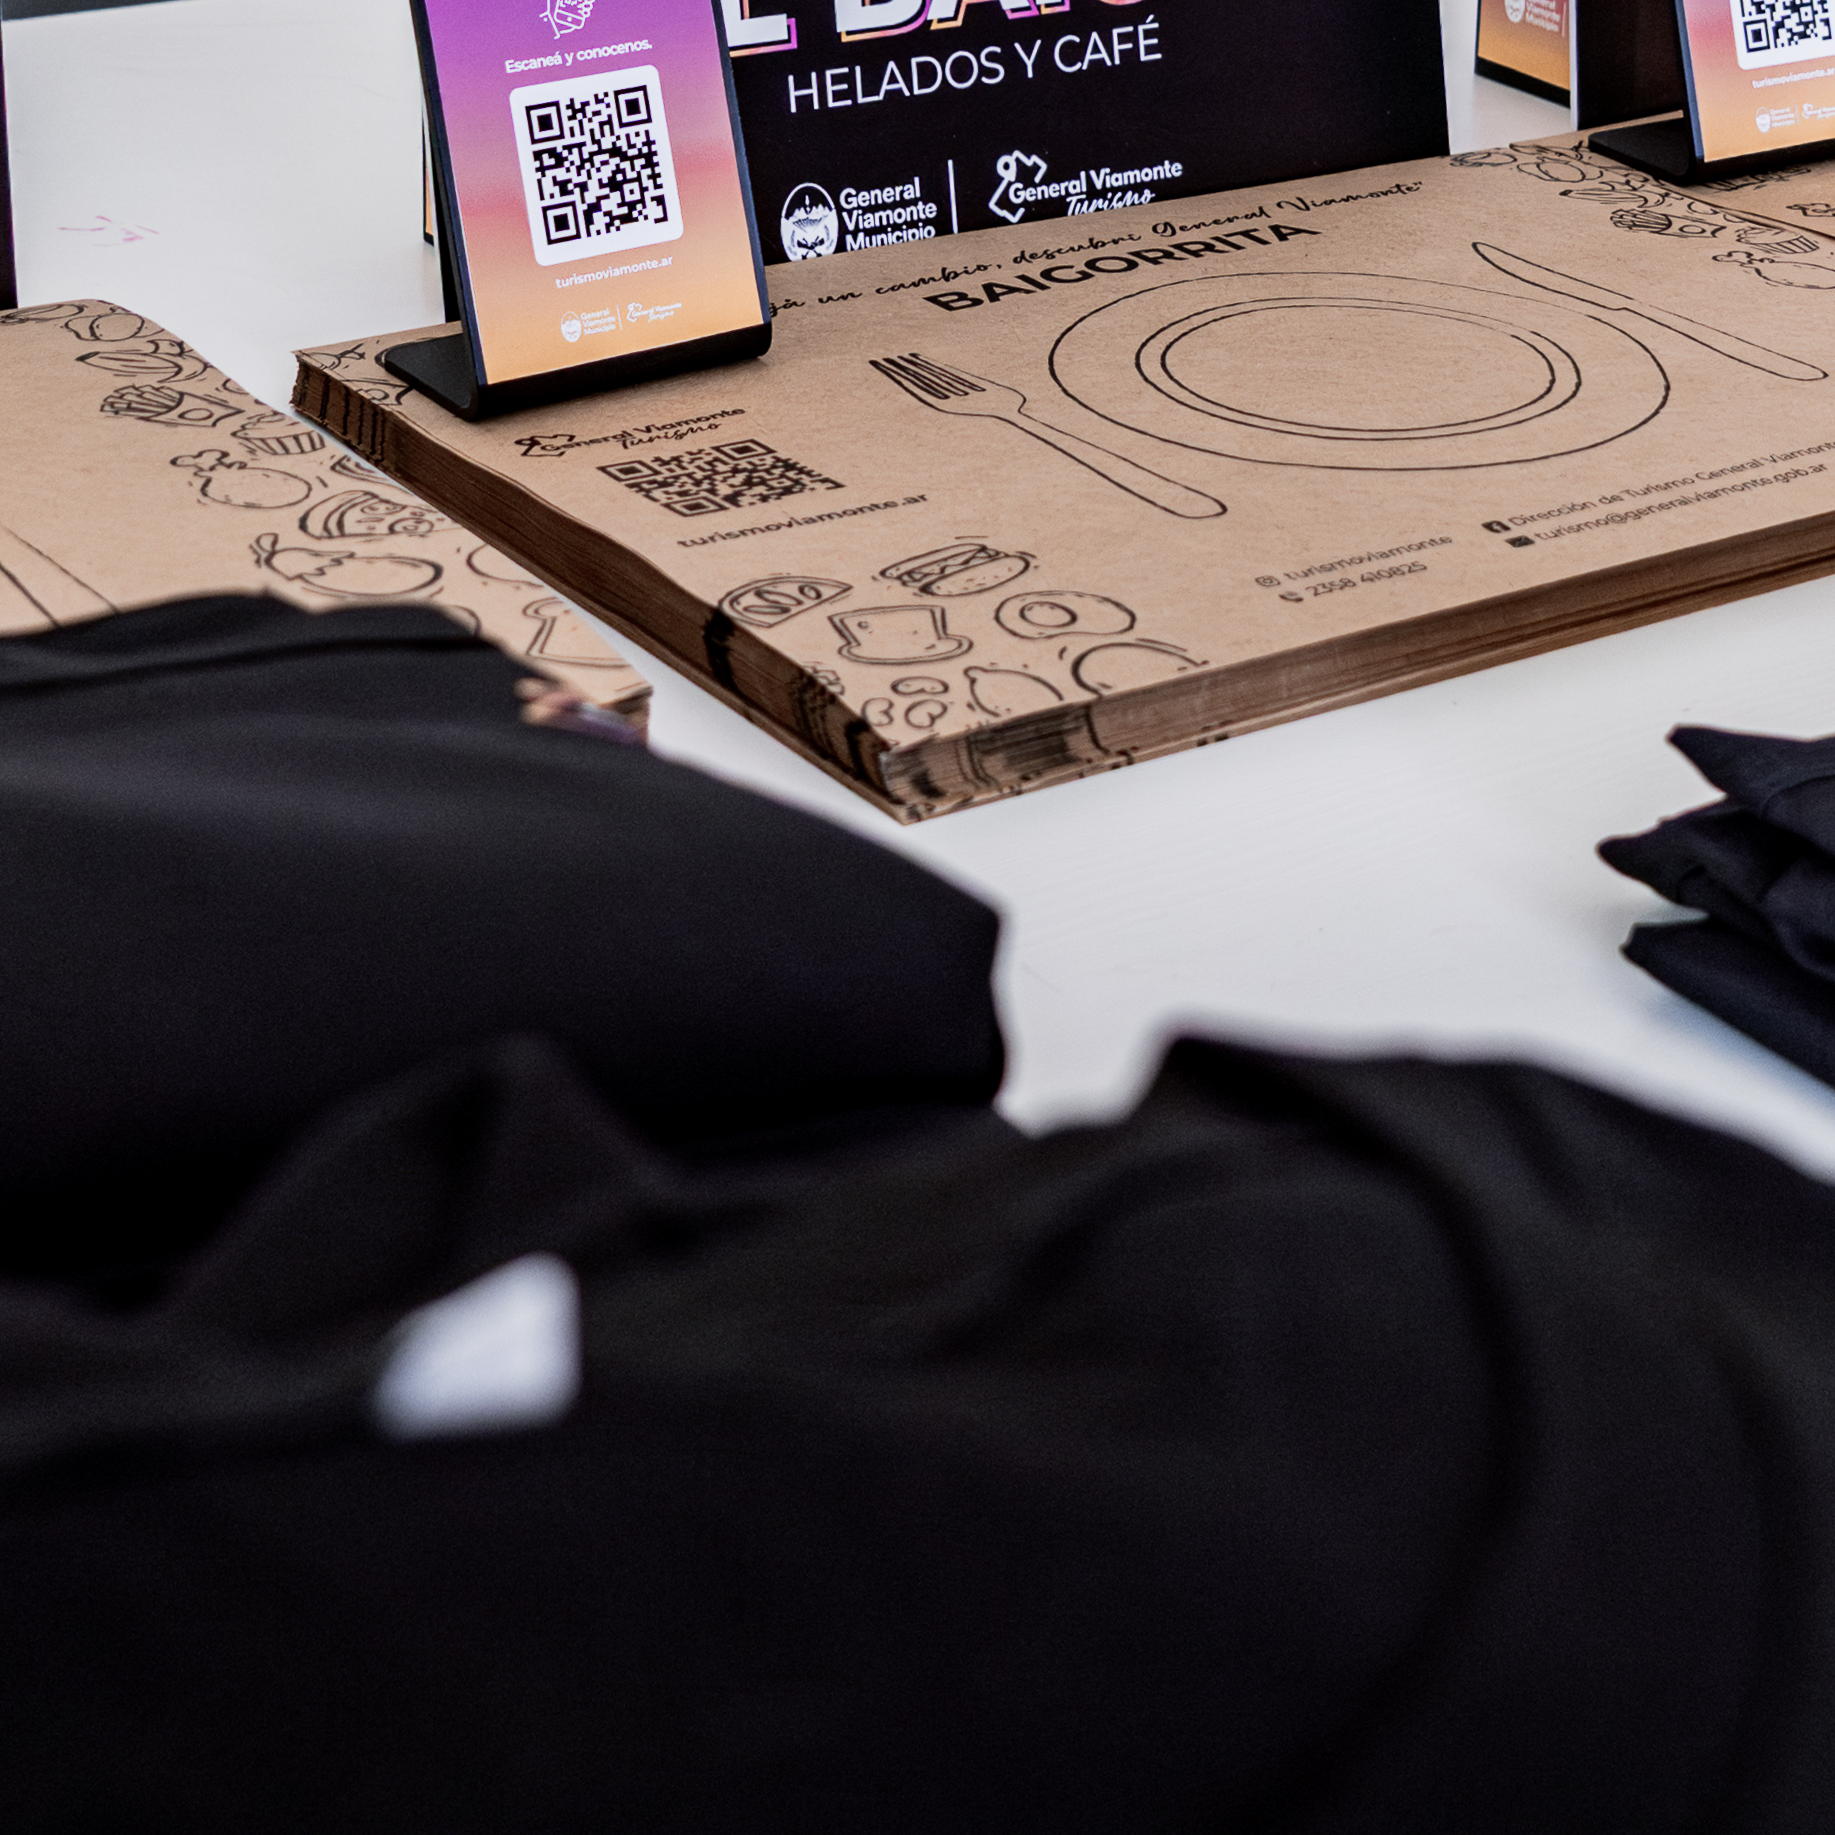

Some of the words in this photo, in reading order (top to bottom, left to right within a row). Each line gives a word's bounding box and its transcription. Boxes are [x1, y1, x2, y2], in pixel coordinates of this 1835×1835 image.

[505, 51, 563, 73] Escaneá
[564, 52, 574, 66] y
[576, 39, 653, 61] conocenos.
[787, 46, 1005, 113] HELADOS
[1013, 40, 1042, 78] Y
[1053, 14, 1162, 73] CAFÉ
[839, 177, 920, 210] General
[1008, 171, 1087, 204] General
[1088, 159, 1183, 190] Viamonte
[841, 201, 937, 232] Viamonte
[818, 292, 863, 304] un
[1151, 206, 1271, 238] General
[844, 222, 936, 252] Municipio
[555, 256, 673, 289] turismoviamonte.ar
[922, 223, 1322, 312] BAIGORRITA
[631, 407, 746, 434] Viamonte
[1508, 500, 1597, 527] Dirección
[1598, 493, 1622, 506] de
[1621, 475, 1696, 502] Turismo
[1695, 458, 1765, 482] General
[677, 492, 929, 548] turismoviamonte.ar
[1284, 535, 1453, 581] turismoviamonte
[1306, 577, 1357, 596] 2358
[1360, 561, 1428, 583] 410825
